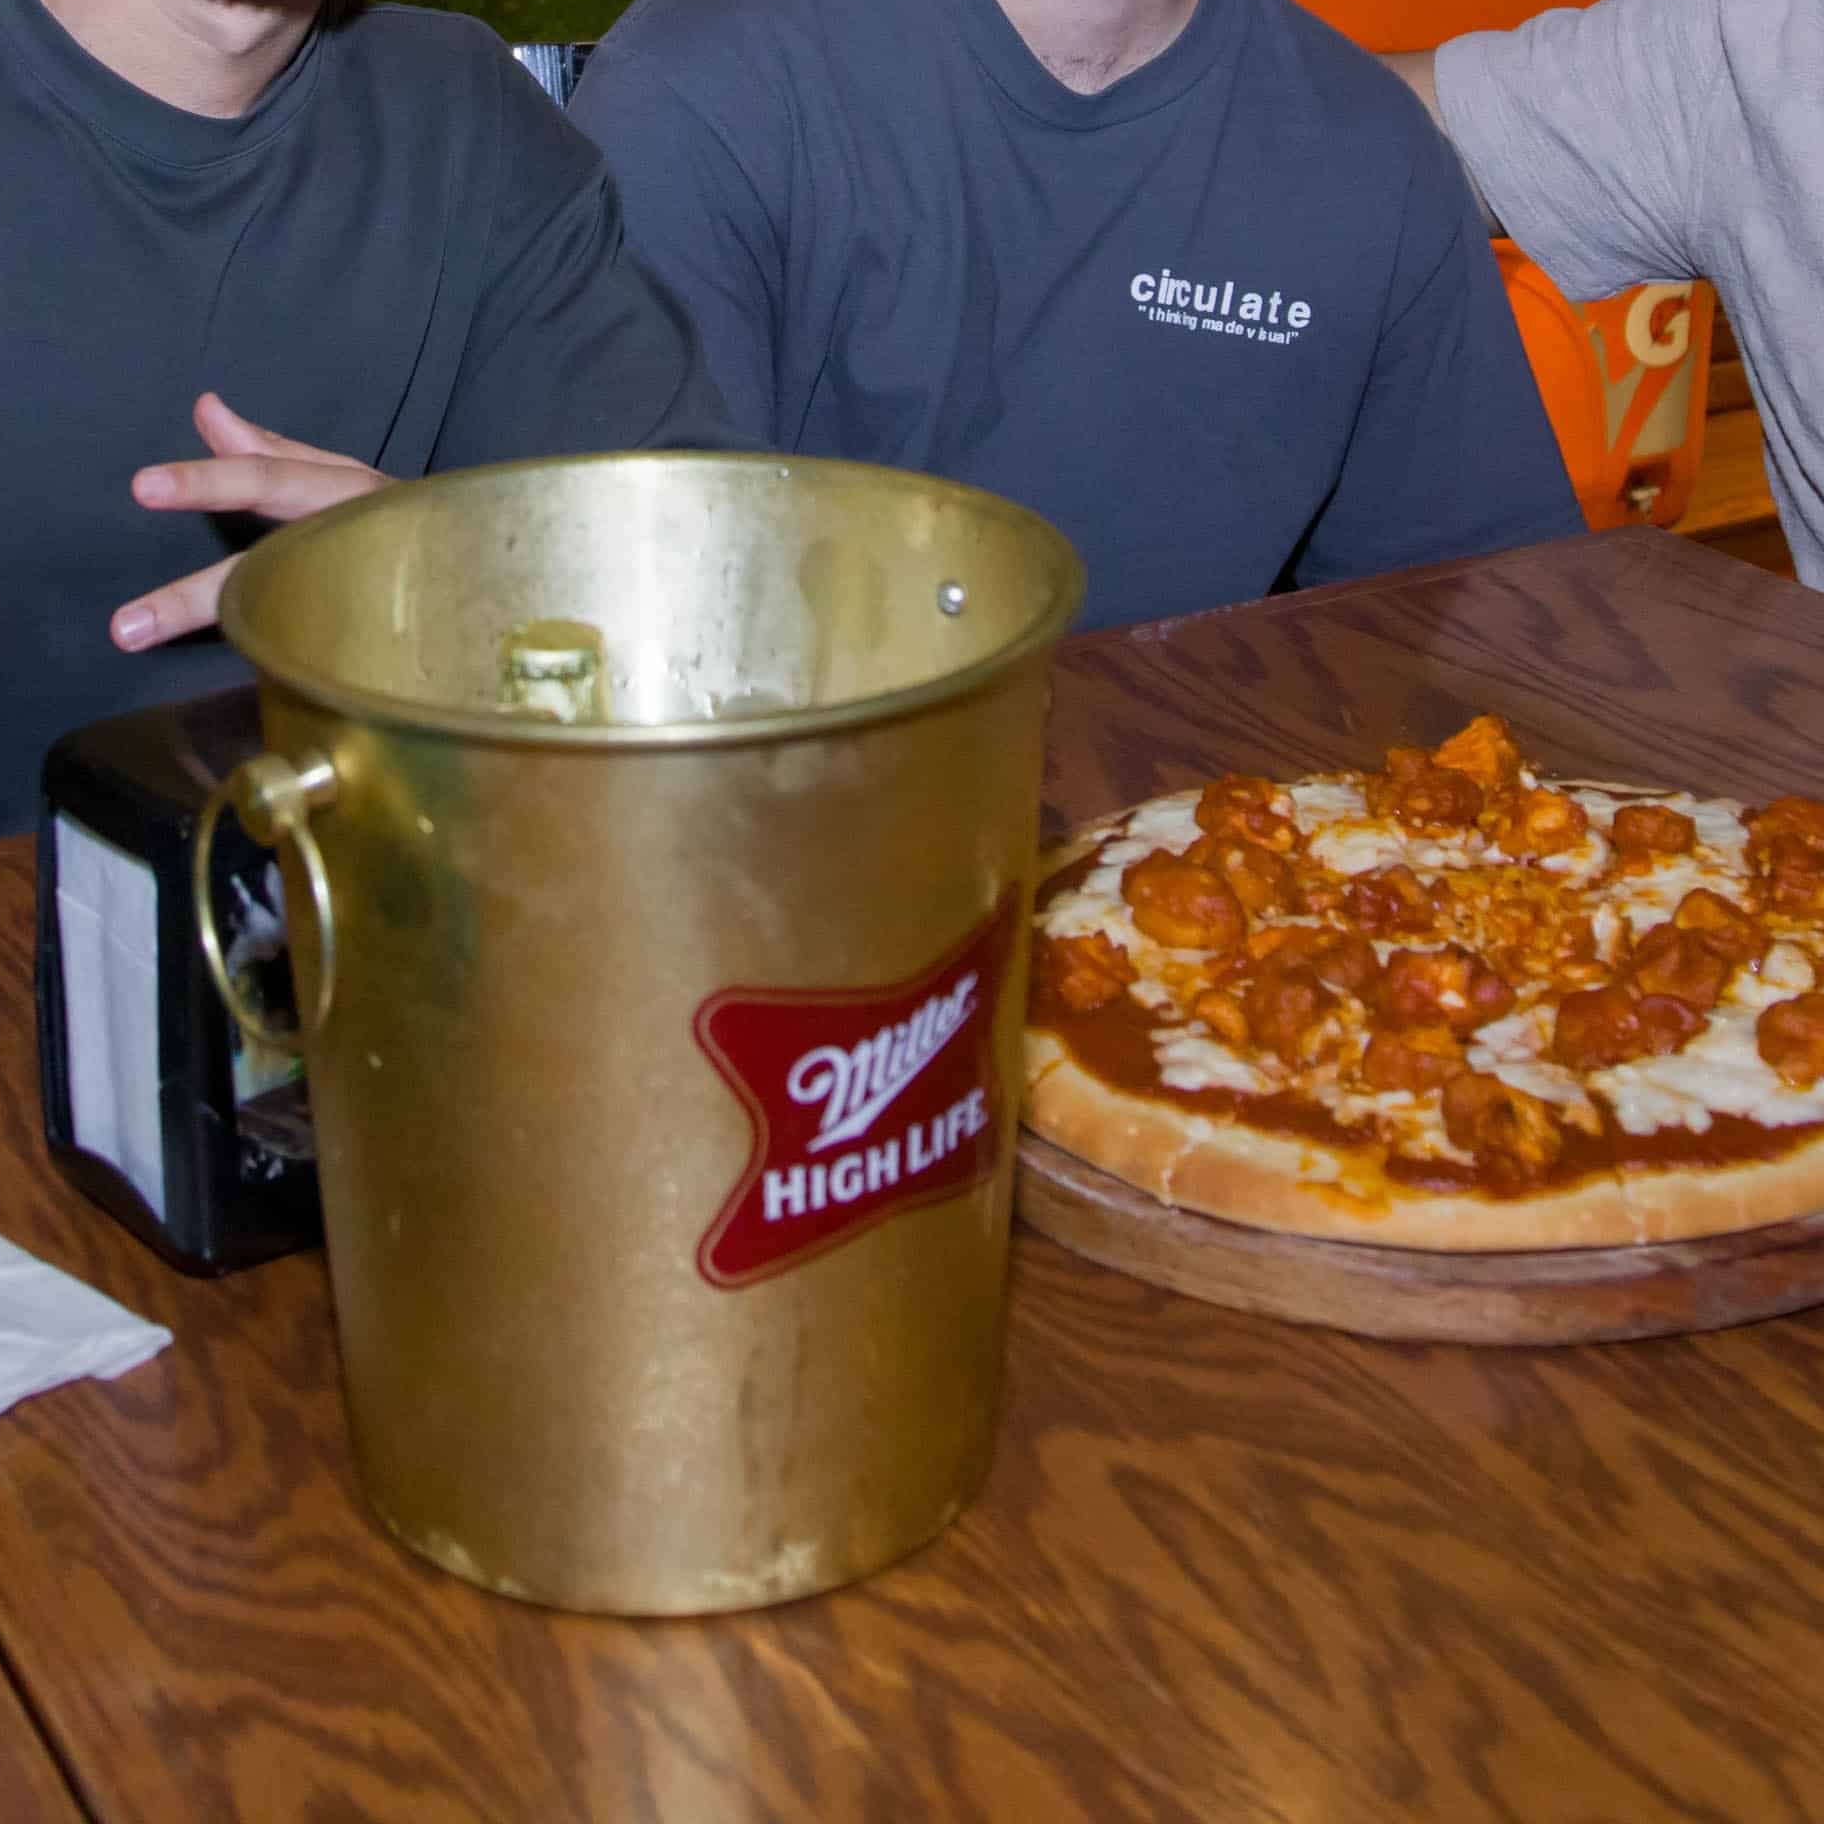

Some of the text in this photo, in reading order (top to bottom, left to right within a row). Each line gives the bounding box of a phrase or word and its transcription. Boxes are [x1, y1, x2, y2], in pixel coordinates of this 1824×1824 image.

[1130, 268, 1312, 329] circulate
[1202, 317, 1245, 336] made
[1625, 281, 1695, 367] G
[786, 971, 978, 1154] Miller
[763, 1088, 988, 1222] HIGH LIFE
